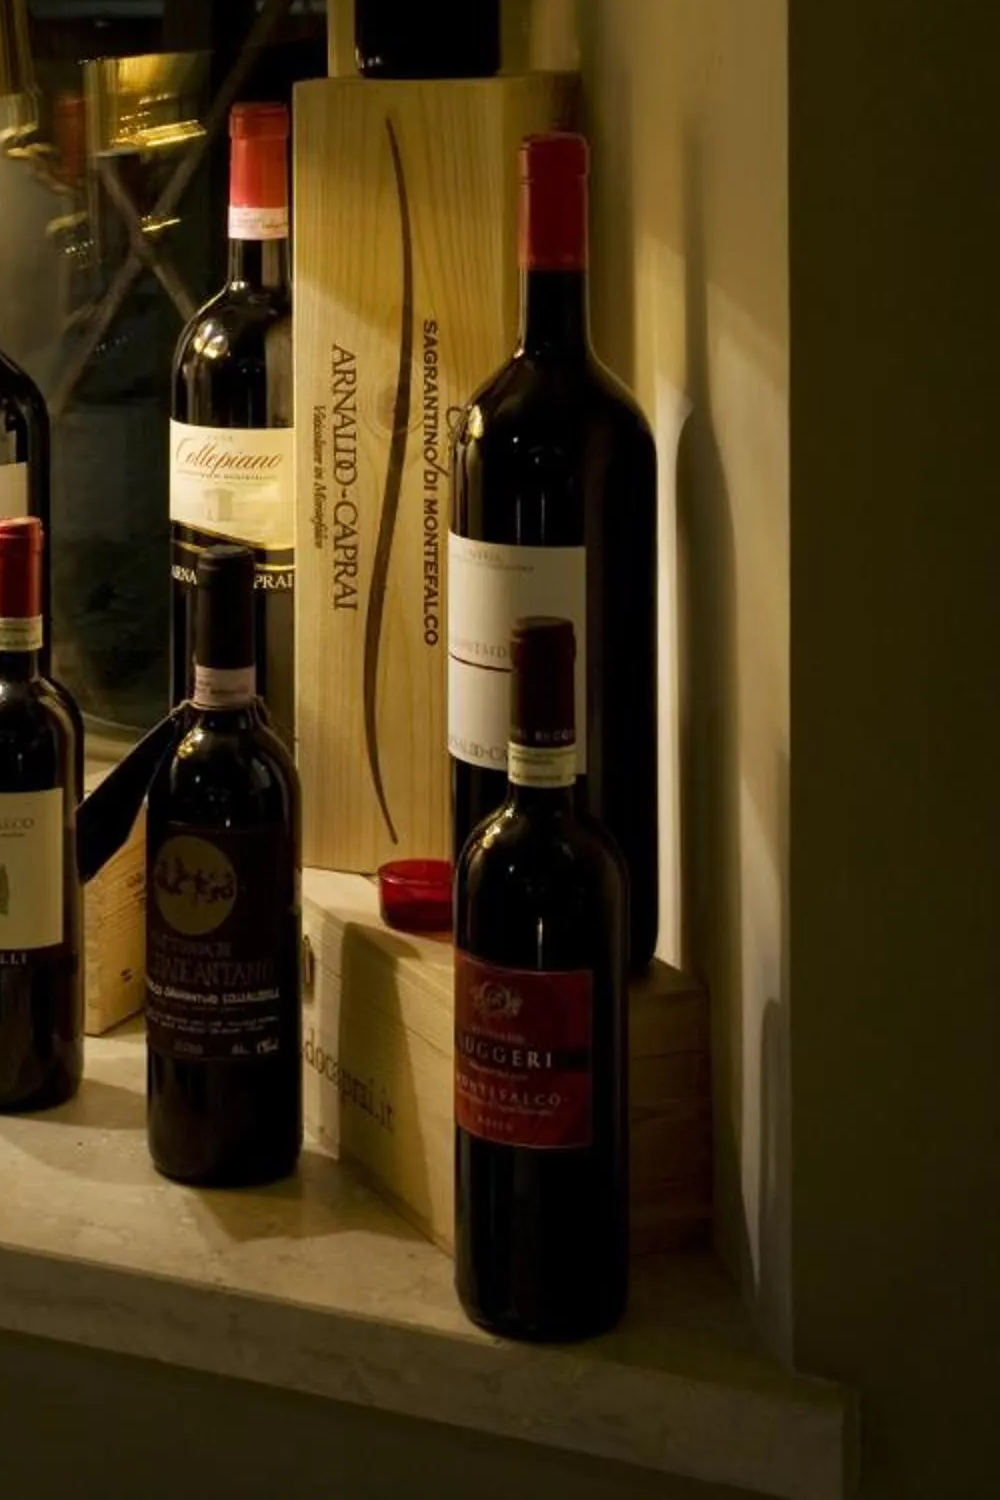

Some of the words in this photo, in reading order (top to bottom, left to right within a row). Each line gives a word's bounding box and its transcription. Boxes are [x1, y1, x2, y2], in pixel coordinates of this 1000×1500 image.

[423, 319, 439, 465] SAGRANTINO
[176, 437, 283, 476] Collepiano
[331, 343, 359, 612] ARNALDO-CAPRAI
[423, 471, 439, 492] DI
[423, 498, 439, 646] MONTEFALCO
[302, 1027, 395, 1134] docaprai.it
